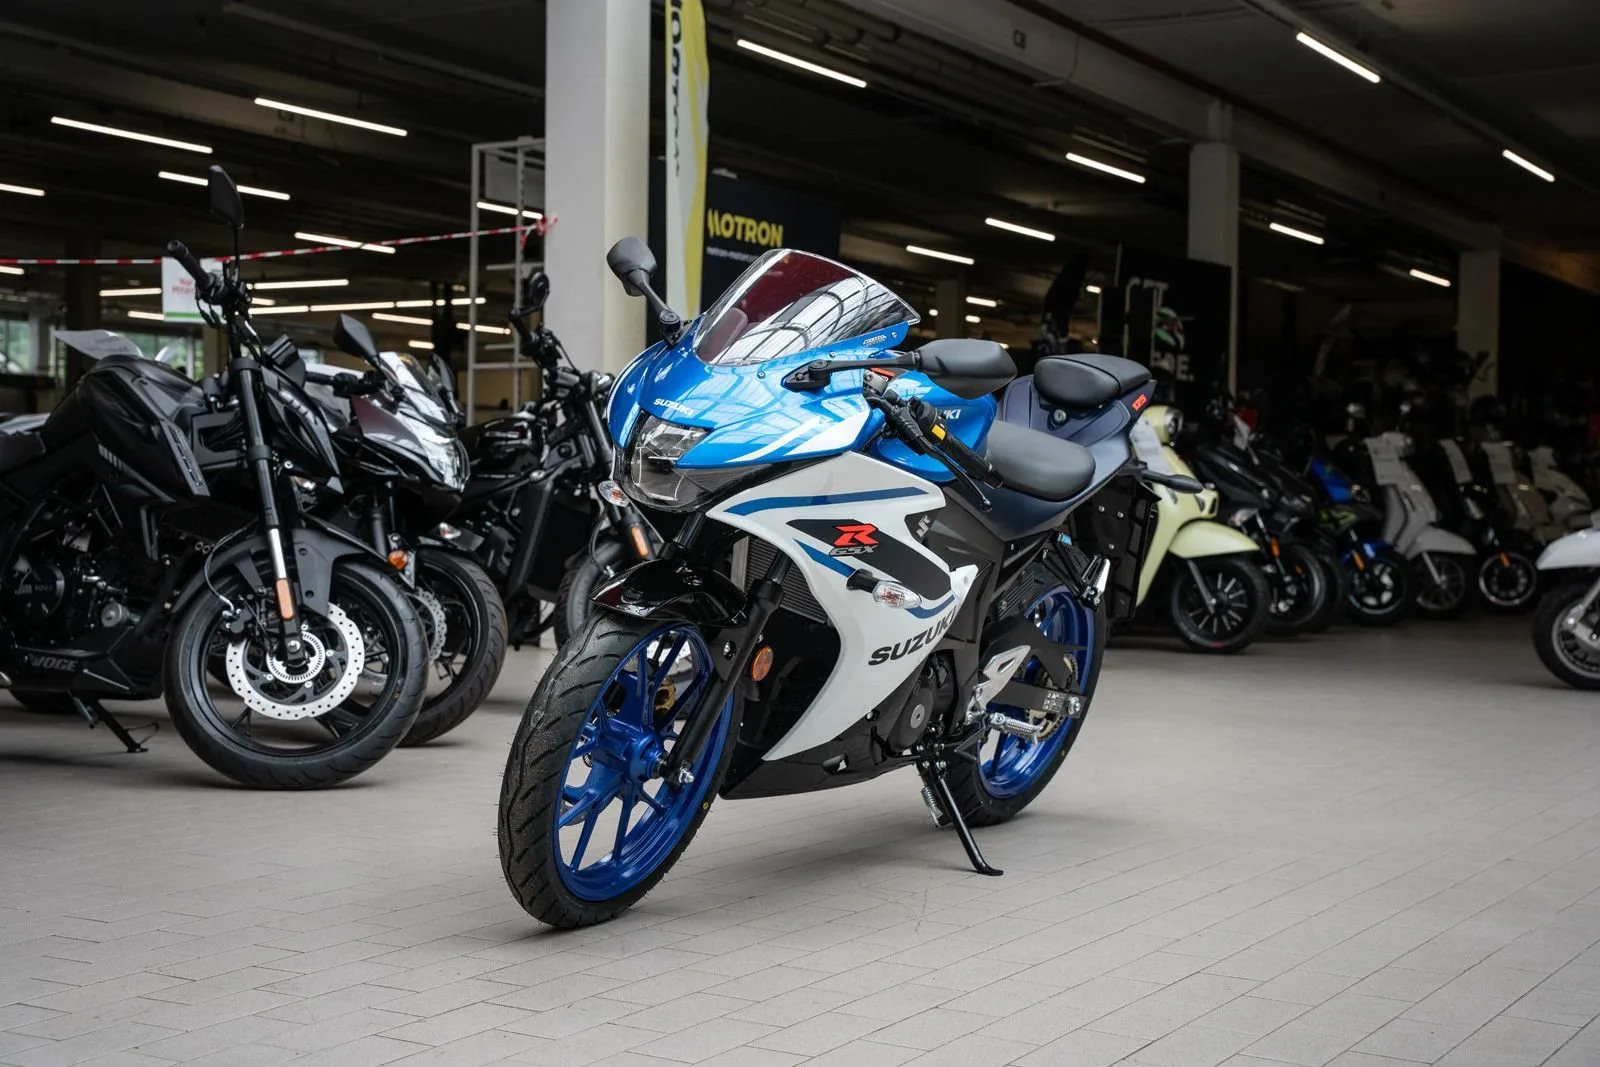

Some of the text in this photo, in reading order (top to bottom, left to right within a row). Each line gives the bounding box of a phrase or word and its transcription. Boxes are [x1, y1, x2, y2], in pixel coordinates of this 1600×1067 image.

[653, 398, 694, 416] SUZUKI
[834, 524, 879, 546] R
[829, 545, 878, 555] GSX
[868, 605, 956, 666] SUZUKI
